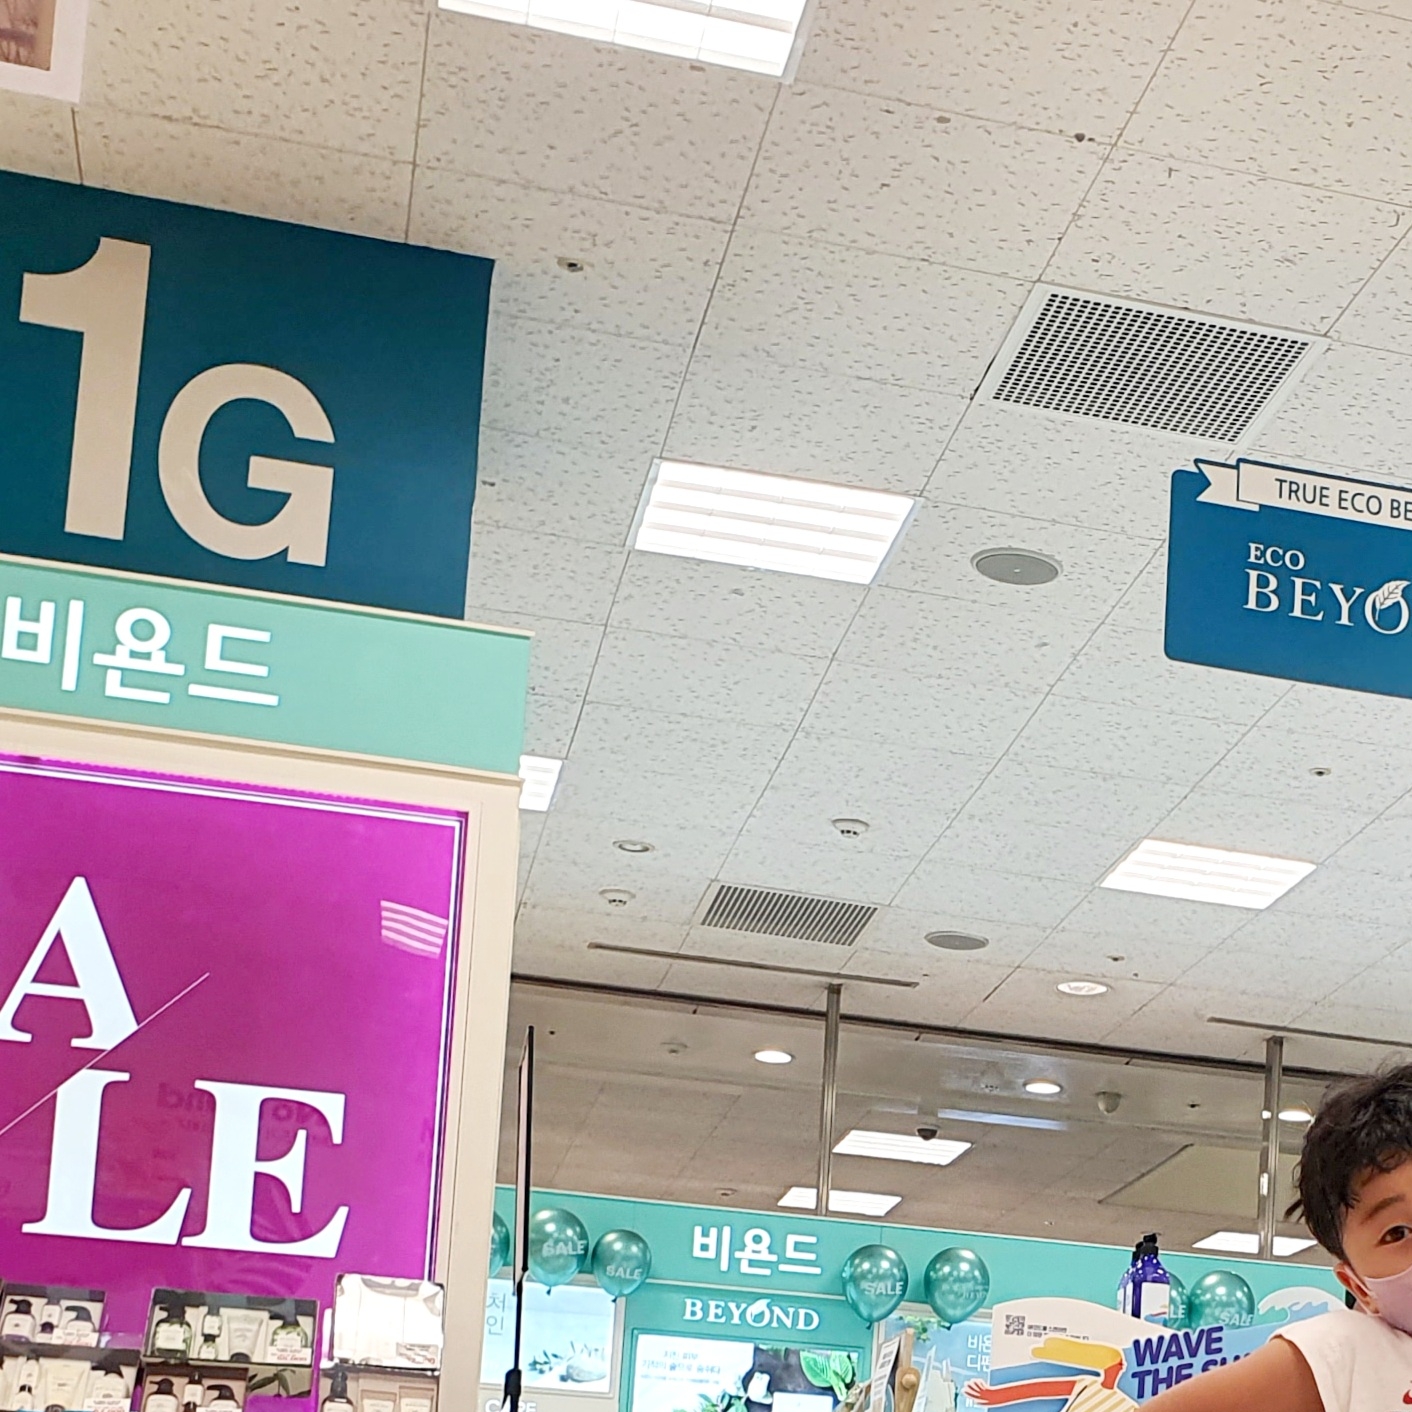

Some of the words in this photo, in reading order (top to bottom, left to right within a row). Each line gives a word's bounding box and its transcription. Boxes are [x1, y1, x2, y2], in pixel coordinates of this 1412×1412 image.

[19, 236, 336, 567] 1G
[1274, 477, 1330, 508] TRUE
[1337, 492, 1382, 516] ECO
[1247, 543, 1305, 571] ECO
[1, 596, 280, 706] 비욘드
[543, 1240, 587, 1257] SALE
[692, 1225, 822, 1276] 비욘드
[606, 1265, 643, 1279] SALE
[864, 1281, 904, 1295] SALE
[682, 1298, 820, 1331] BEYOND
[1133, 1325, 1224, 1368] WAVE
